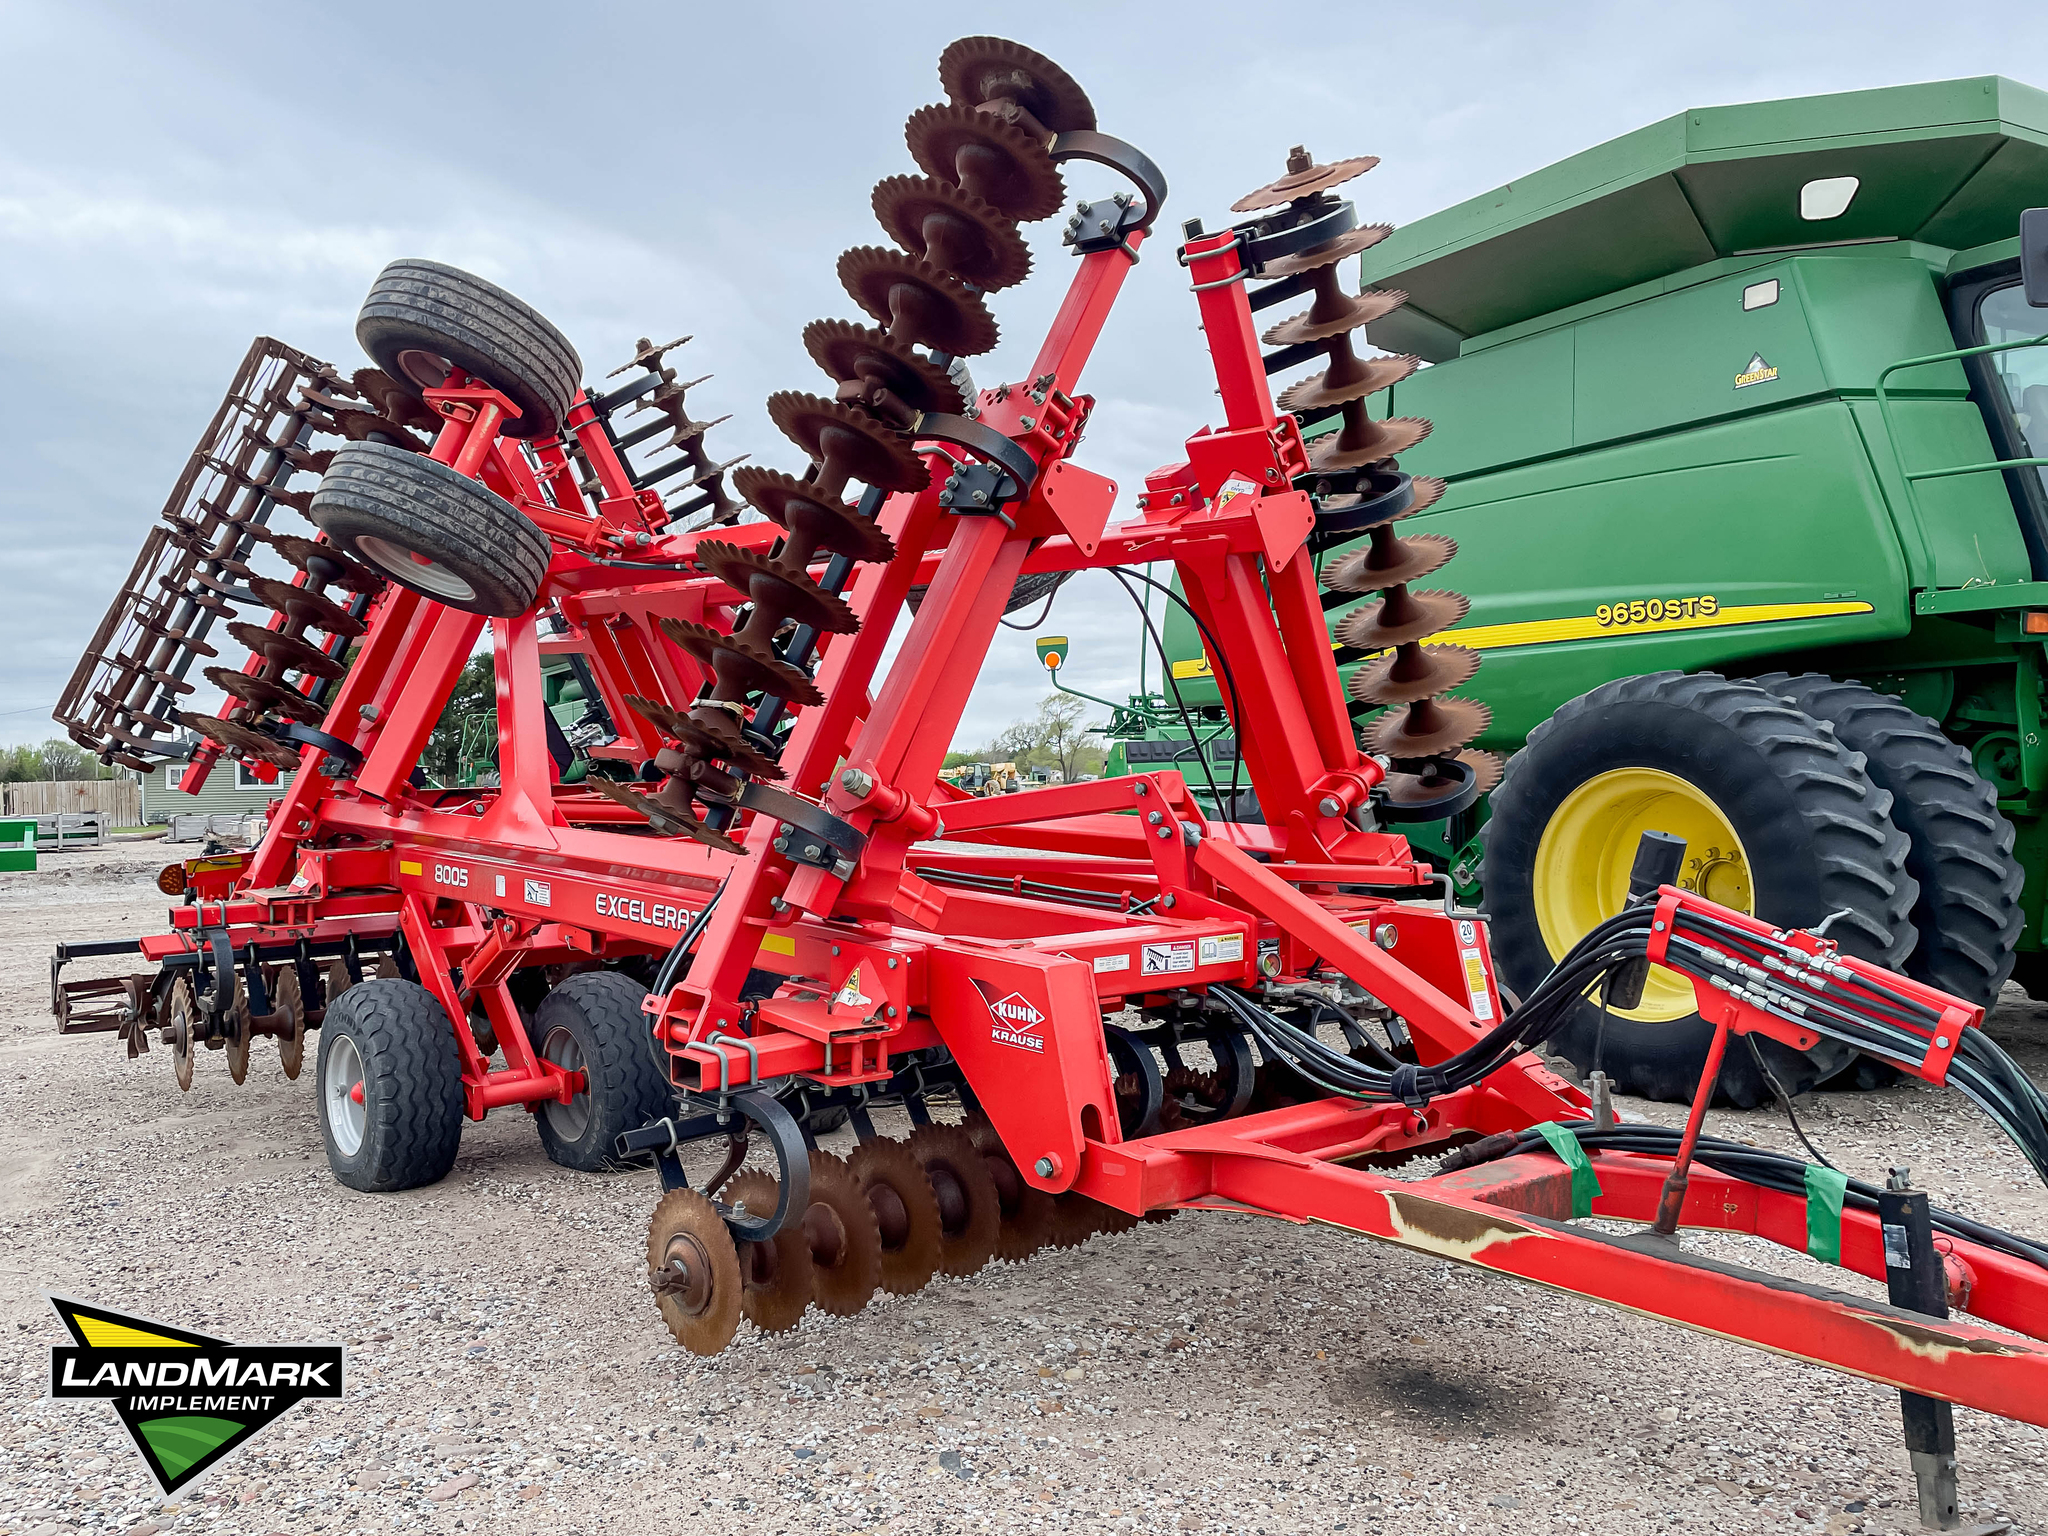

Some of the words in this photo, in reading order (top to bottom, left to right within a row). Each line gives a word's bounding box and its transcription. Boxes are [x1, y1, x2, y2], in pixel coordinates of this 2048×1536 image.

[1595, 595, 1718, 627] 9650STS
[434, 864, 468, 888] 8005
[1461, 924, 1472, 936] 20
[998, 1002, 1037, 1024] KUHN
[991, 1029, 1044, 1049] KRAUSE
